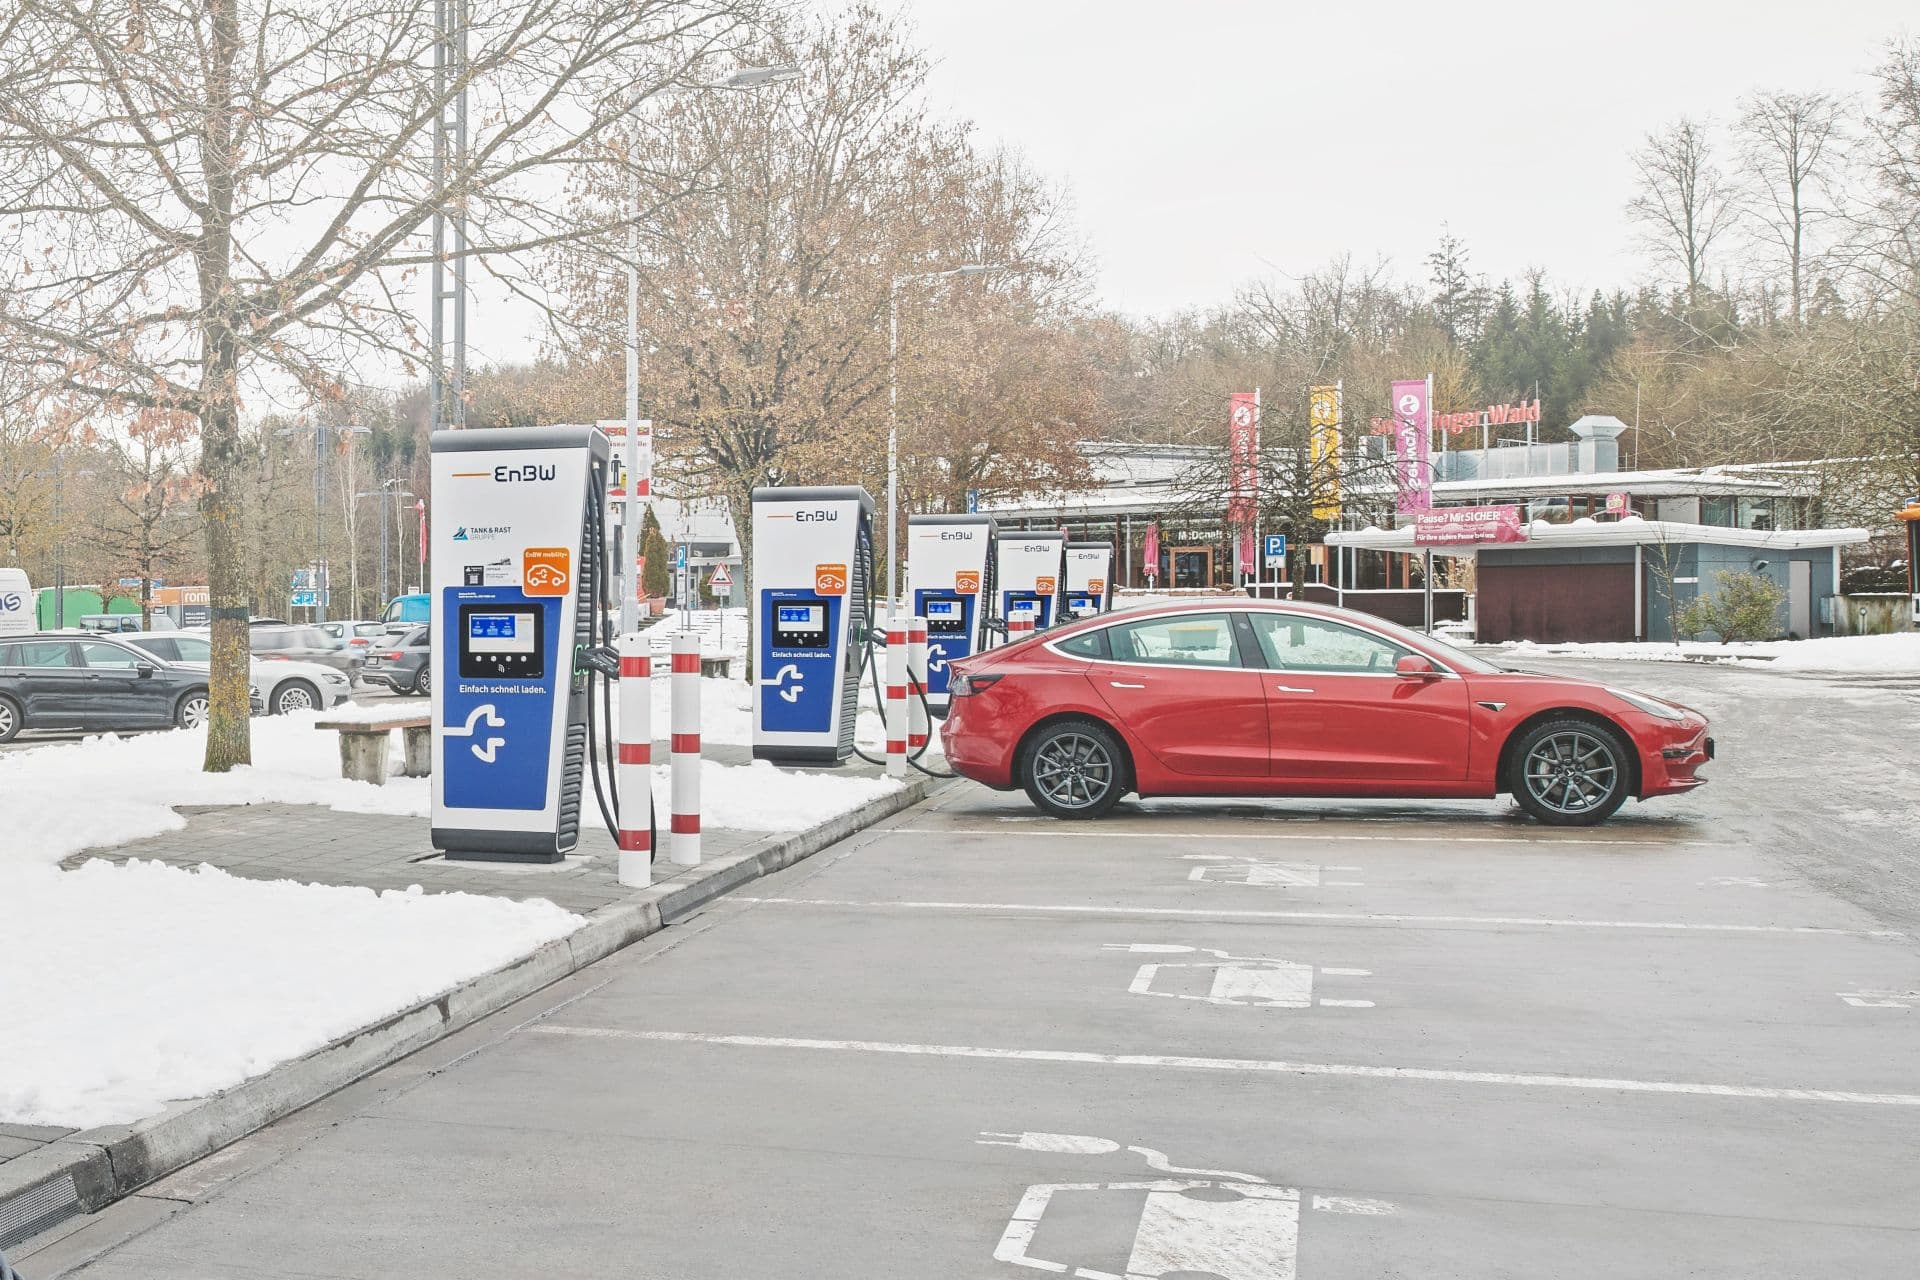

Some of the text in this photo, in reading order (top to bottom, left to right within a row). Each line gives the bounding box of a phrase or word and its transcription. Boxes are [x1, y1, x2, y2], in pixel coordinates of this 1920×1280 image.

[1488, 399, 1541, 424] Wald
[494, 464, 555, 482] EnBW
[796, 510, 838, 521] EnBW
[1417, 514, 1449, 524] Pause?
[1450, 512, 1464, 522] Mit
[941, 531, 973, 541] EnBW
[1024, 545, 1051, 553] EnBW
[1269, 538, 1280, 554] P
[184, 592, 210, 603] rom
[814, 651, 832, 659] laden.
[459, 684, 547, 694] Einfach schnell laden.
